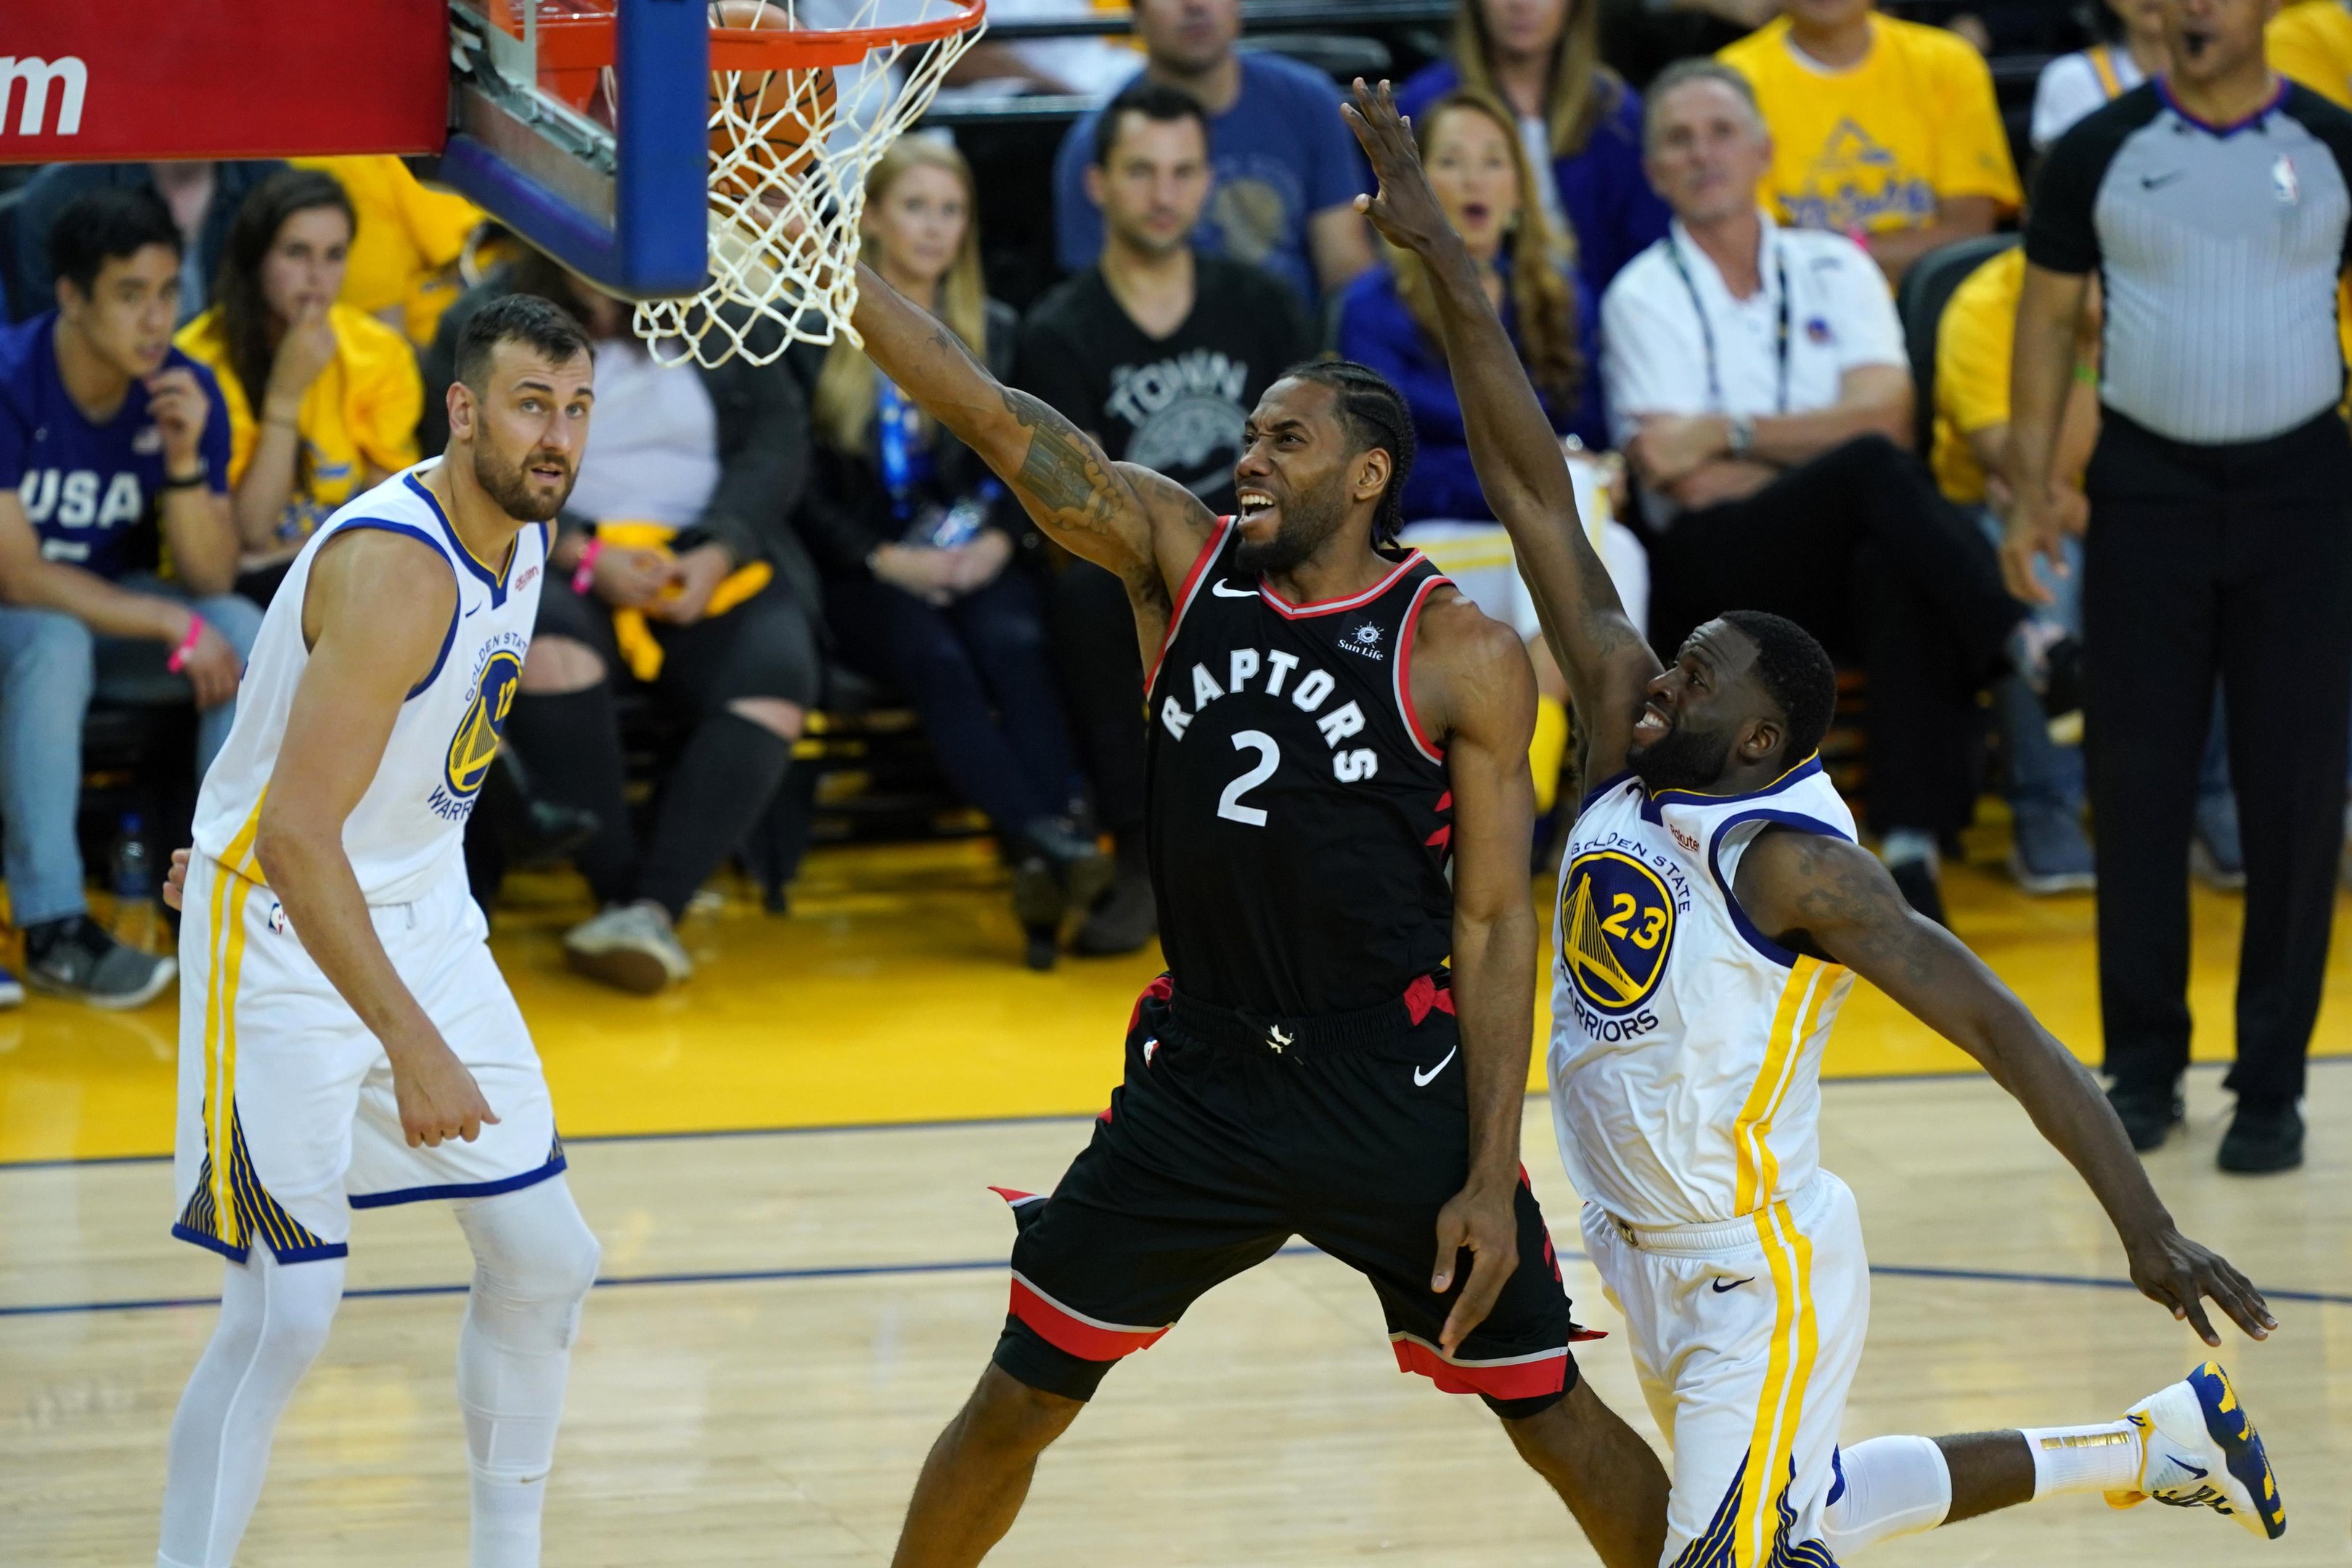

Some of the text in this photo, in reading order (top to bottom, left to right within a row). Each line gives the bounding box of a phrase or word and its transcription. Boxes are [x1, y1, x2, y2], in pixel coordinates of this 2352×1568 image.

[19, 468, 143, 528] USA
[465, 634, 500, 702] GOLDEN
[1337, 639, 1384, 661] Sun Life
[494, 677, 517, 722] 12
[1161, 648, 1379, 783] RAPTORS
[1217, 729, 1281, 828] 2
[1652, 855, 1691, 915] STATE
[1601, 892, 1667, 950] 23
